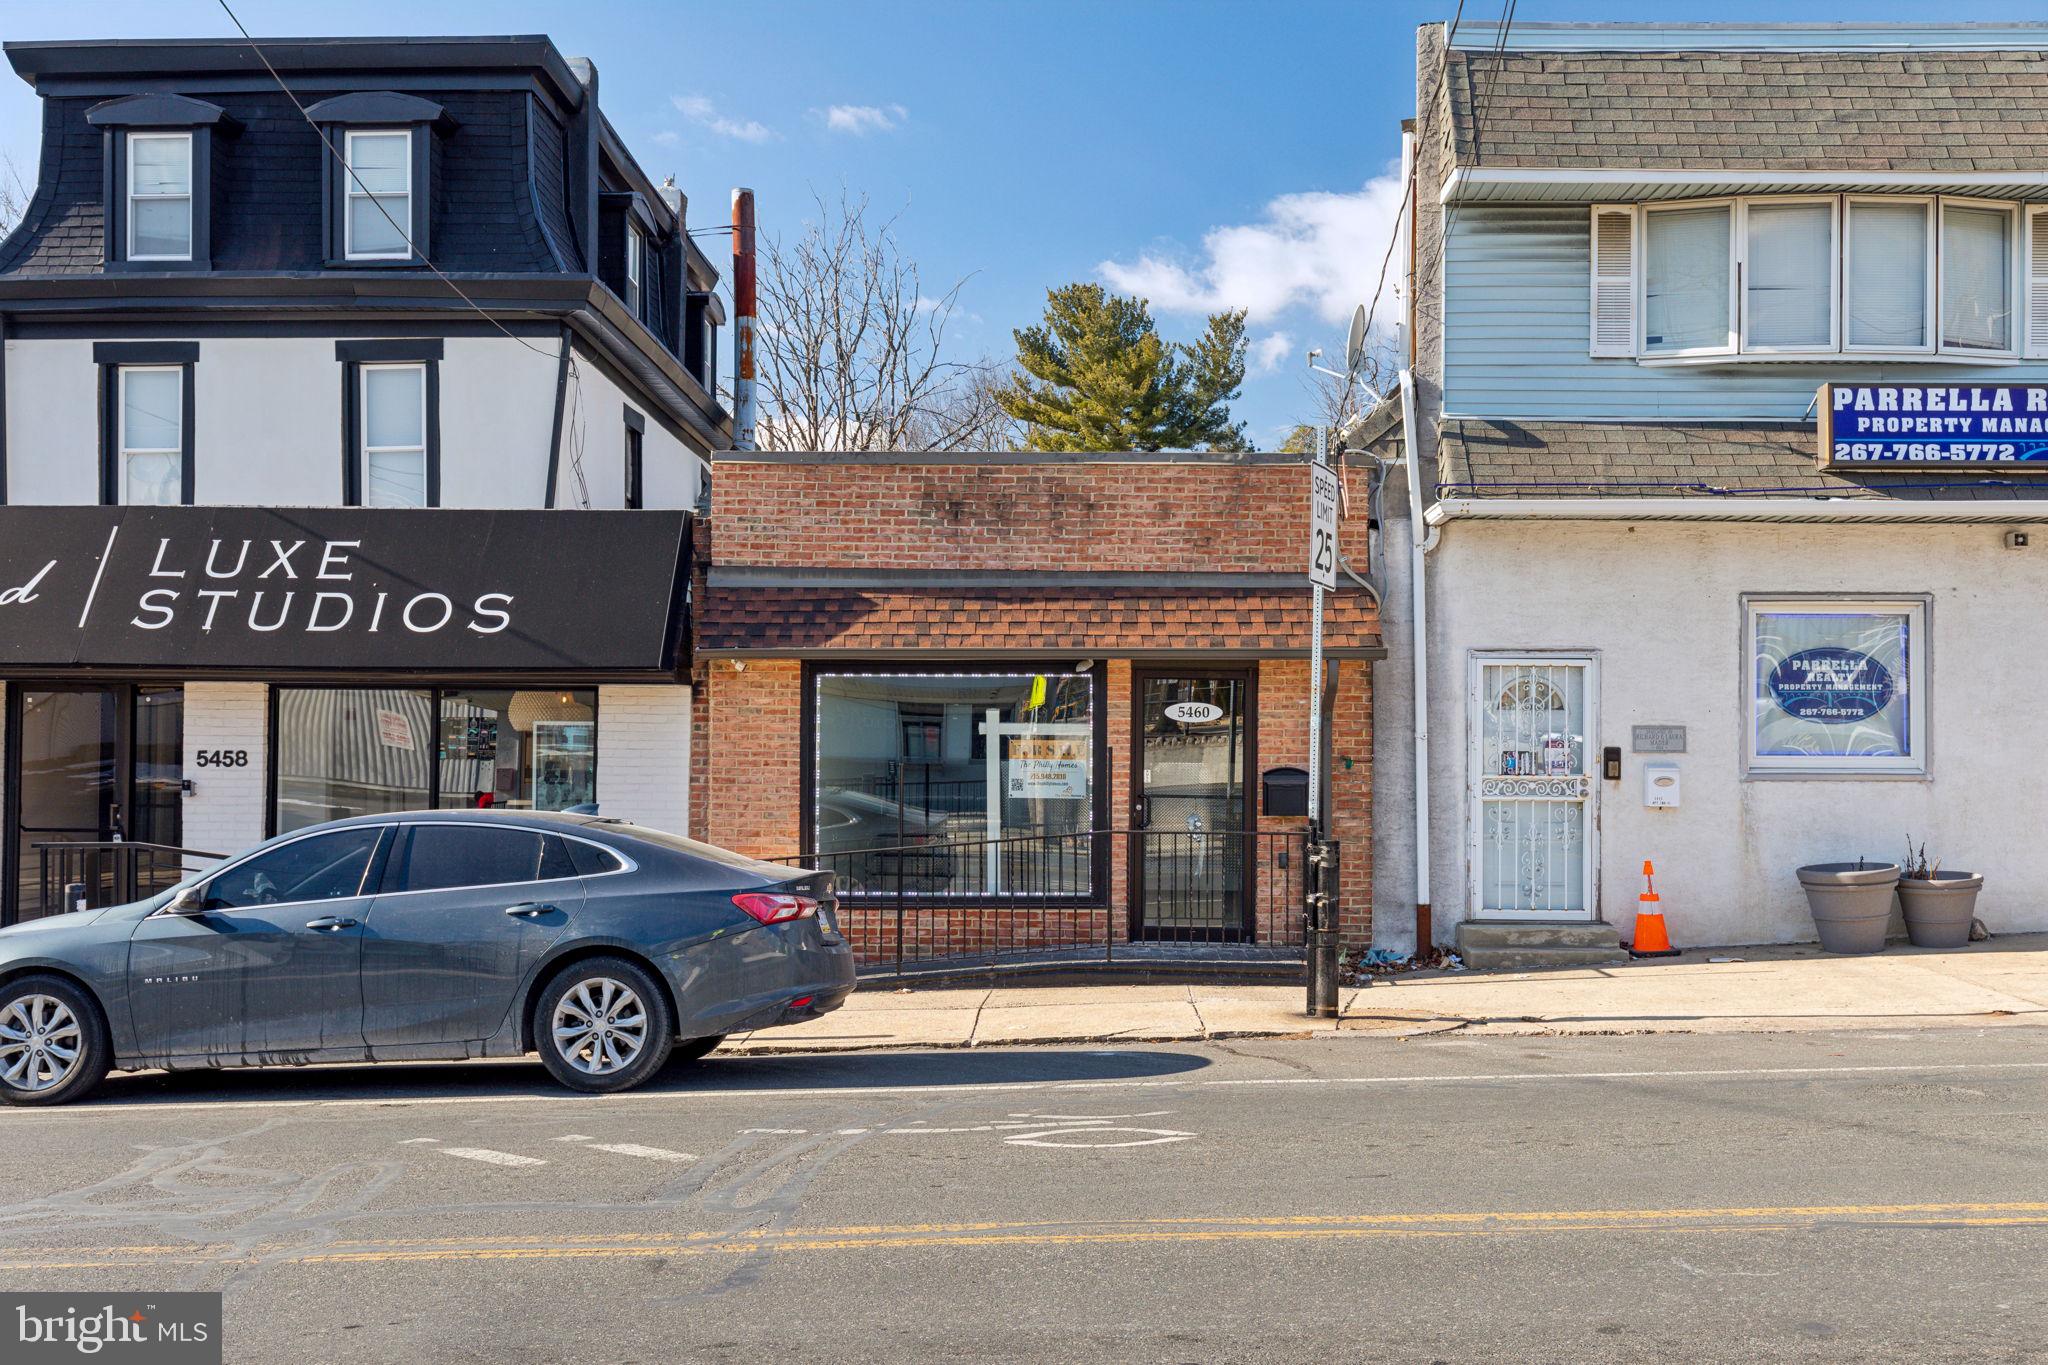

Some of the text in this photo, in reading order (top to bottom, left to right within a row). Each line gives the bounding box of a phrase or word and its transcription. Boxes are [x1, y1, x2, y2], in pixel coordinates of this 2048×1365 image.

[1834, 388, 2048, 411] PARRELLA R
[1858, 417, 2048, 432] PROPERTY MANA
[1835, 443, 2015, 461] 267-766-5772
[1315, 476, 1335, 502] SPEED
[1317, 500, 1333, 524] LIMIT
[150, 539, 361, 581] LUXE
[1315, 528, 1333, 574] 25
[131, 589, 515, 633] STUDIOS
[1792, 660, 1868, 671] PARRELLA
[1178, 706, 1210, 718] 5460
[1800, 708, 1864, 716] 267-766-5772
[196, 750, 248, 768] 5458
[144, 975, 199, 984] MALIBU
